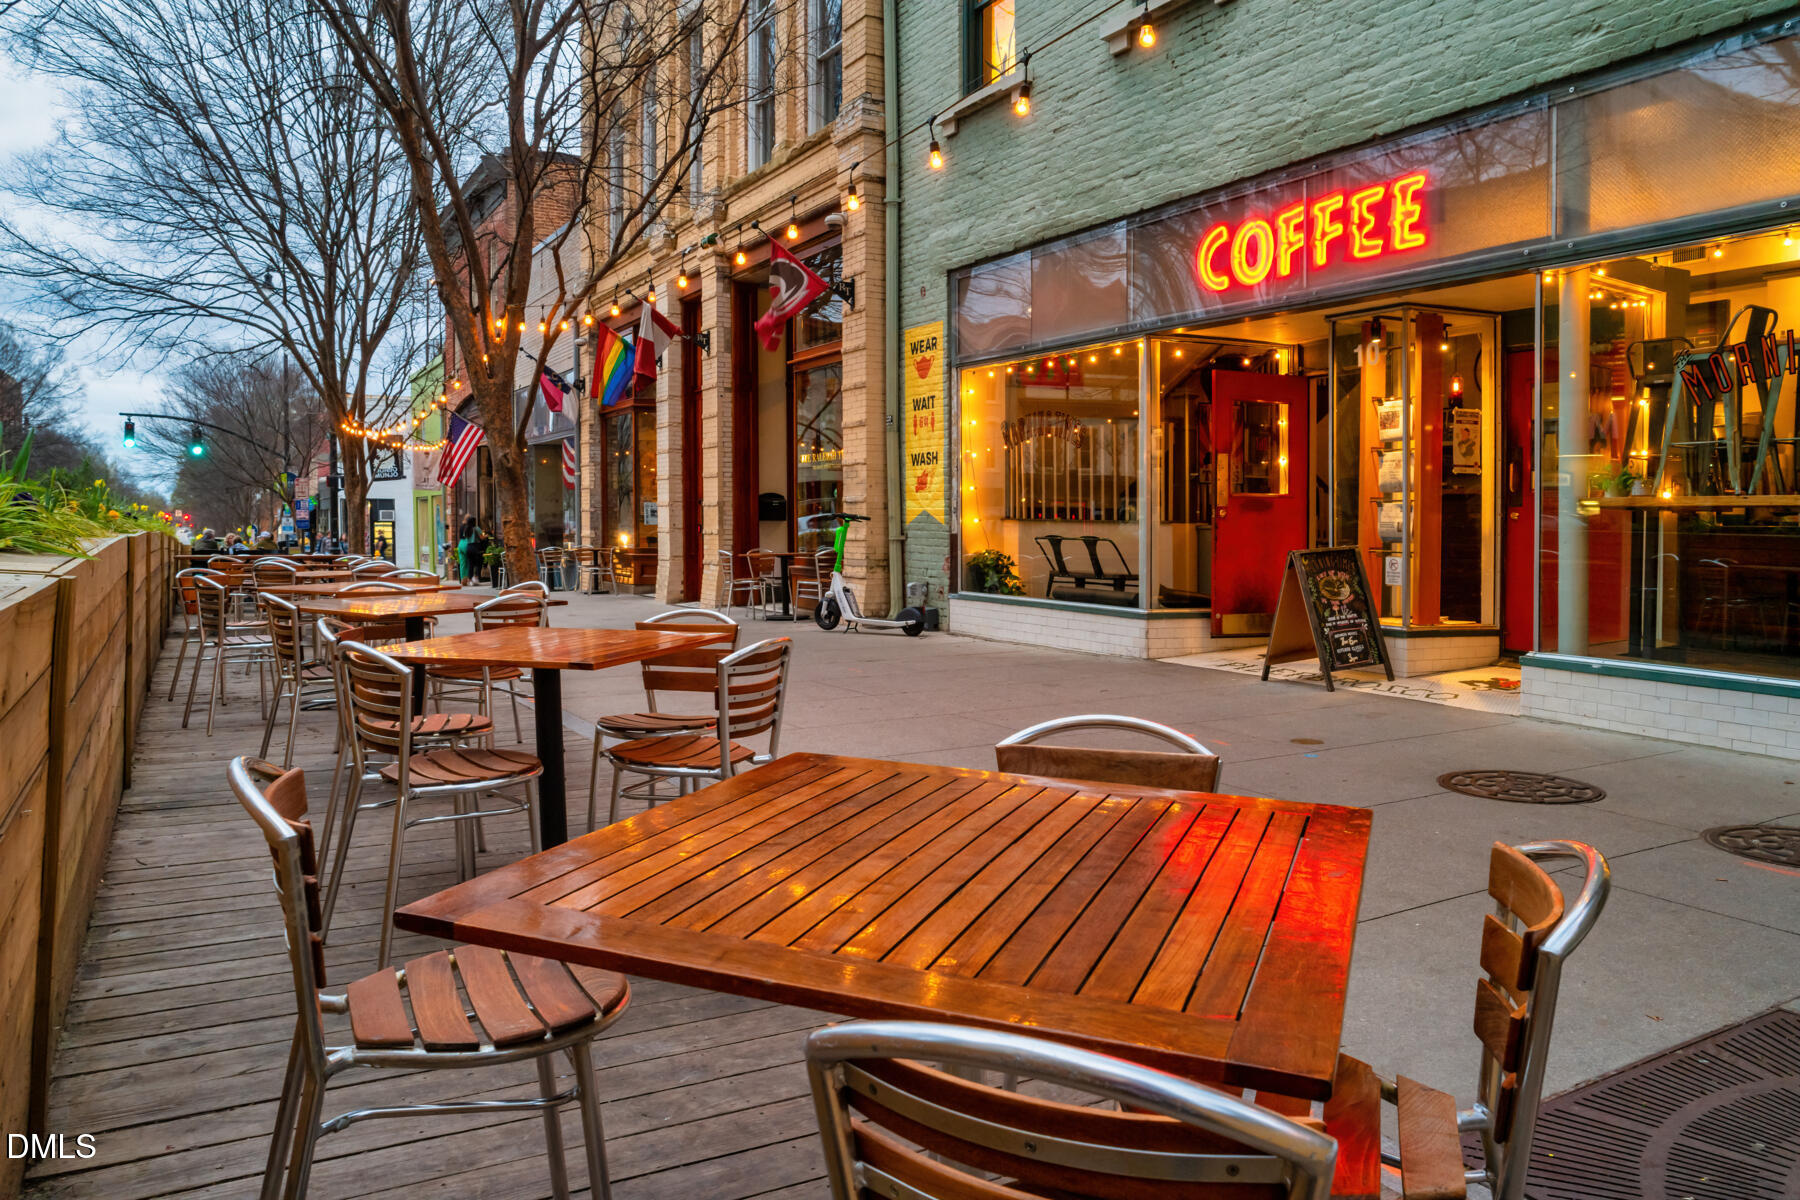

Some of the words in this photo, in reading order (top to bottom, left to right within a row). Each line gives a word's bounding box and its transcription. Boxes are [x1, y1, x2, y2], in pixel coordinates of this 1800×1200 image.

[1196, 173, 1428, 292] COFFEE
[910, 336, 937, 356] WEAR
[1353, 342, 1380, 368] 10
[912, 394, 937, 412] WAIT
[910, 450, 939, 467] WASH
